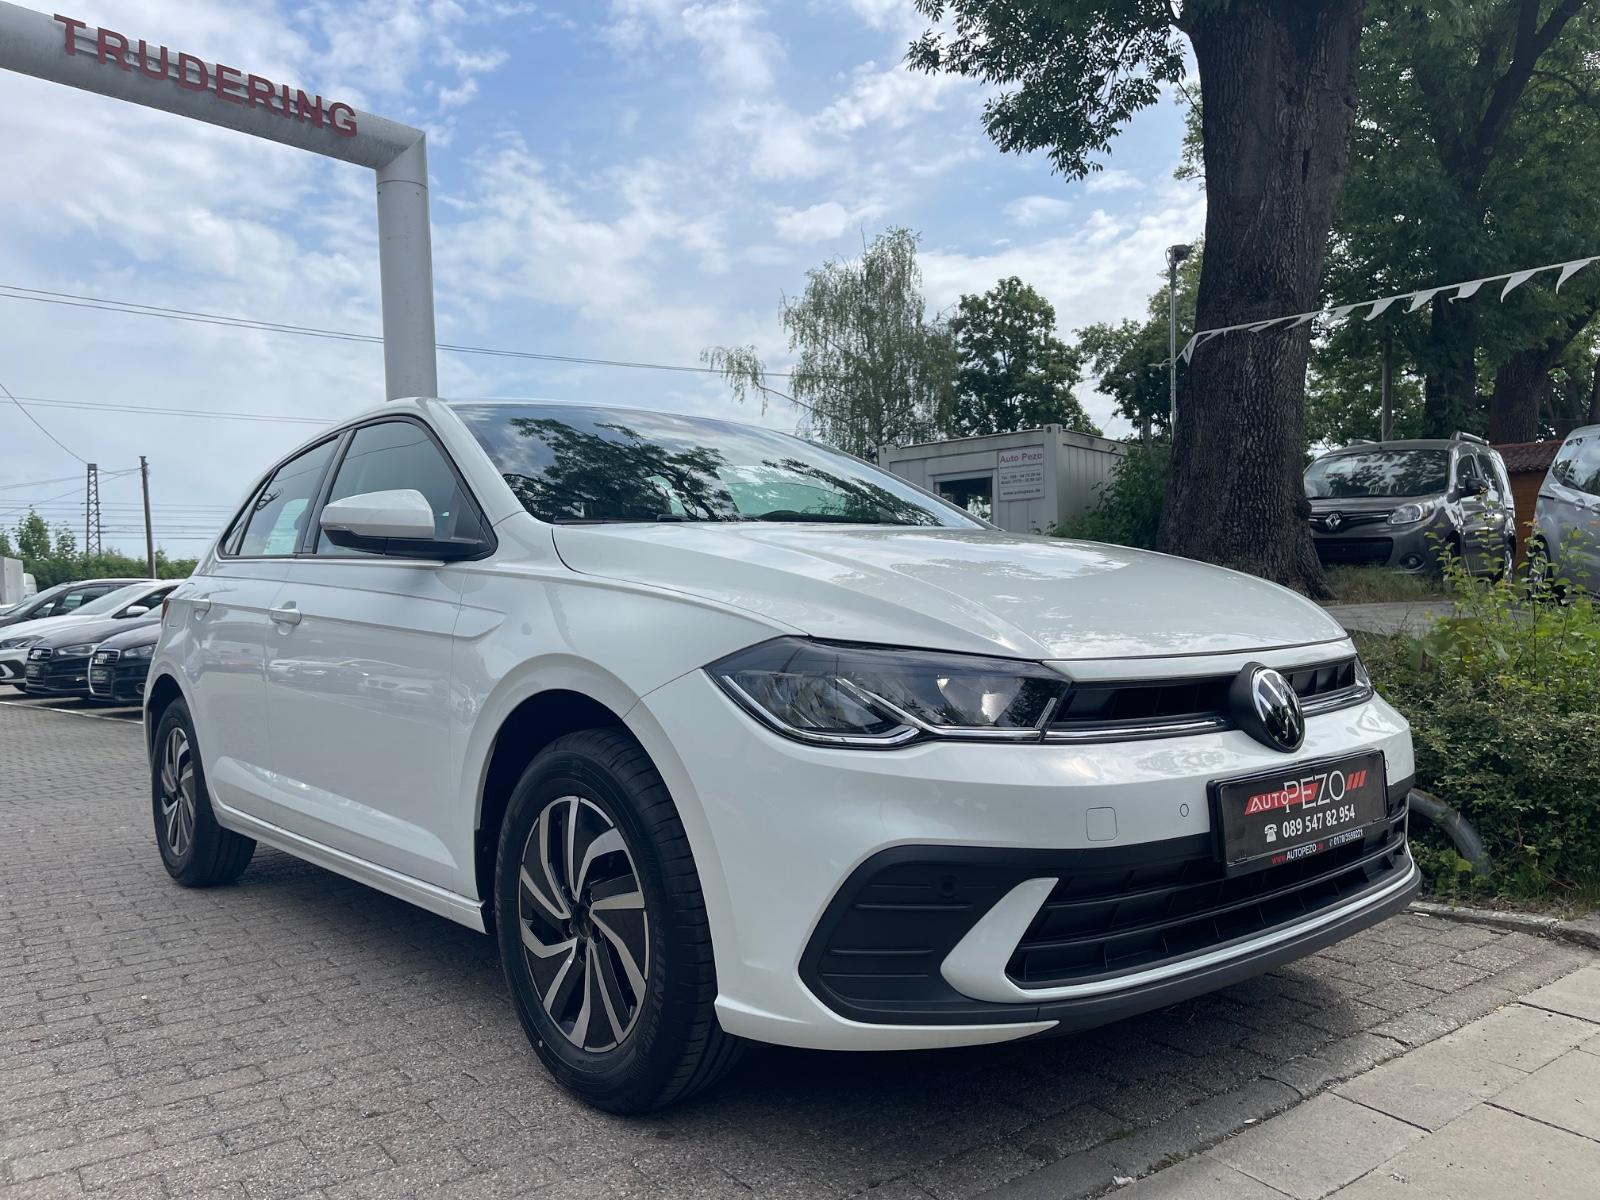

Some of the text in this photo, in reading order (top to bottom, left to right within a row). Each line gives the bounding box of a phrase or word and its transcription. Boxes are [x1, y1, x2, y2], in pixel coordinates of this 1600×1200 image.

[54, 13, 358, 138] TRUDERING
[1000, 452, 1043, 463] Auto Pezo
[1282, 803, 1356, 838] 089 547 82 954
